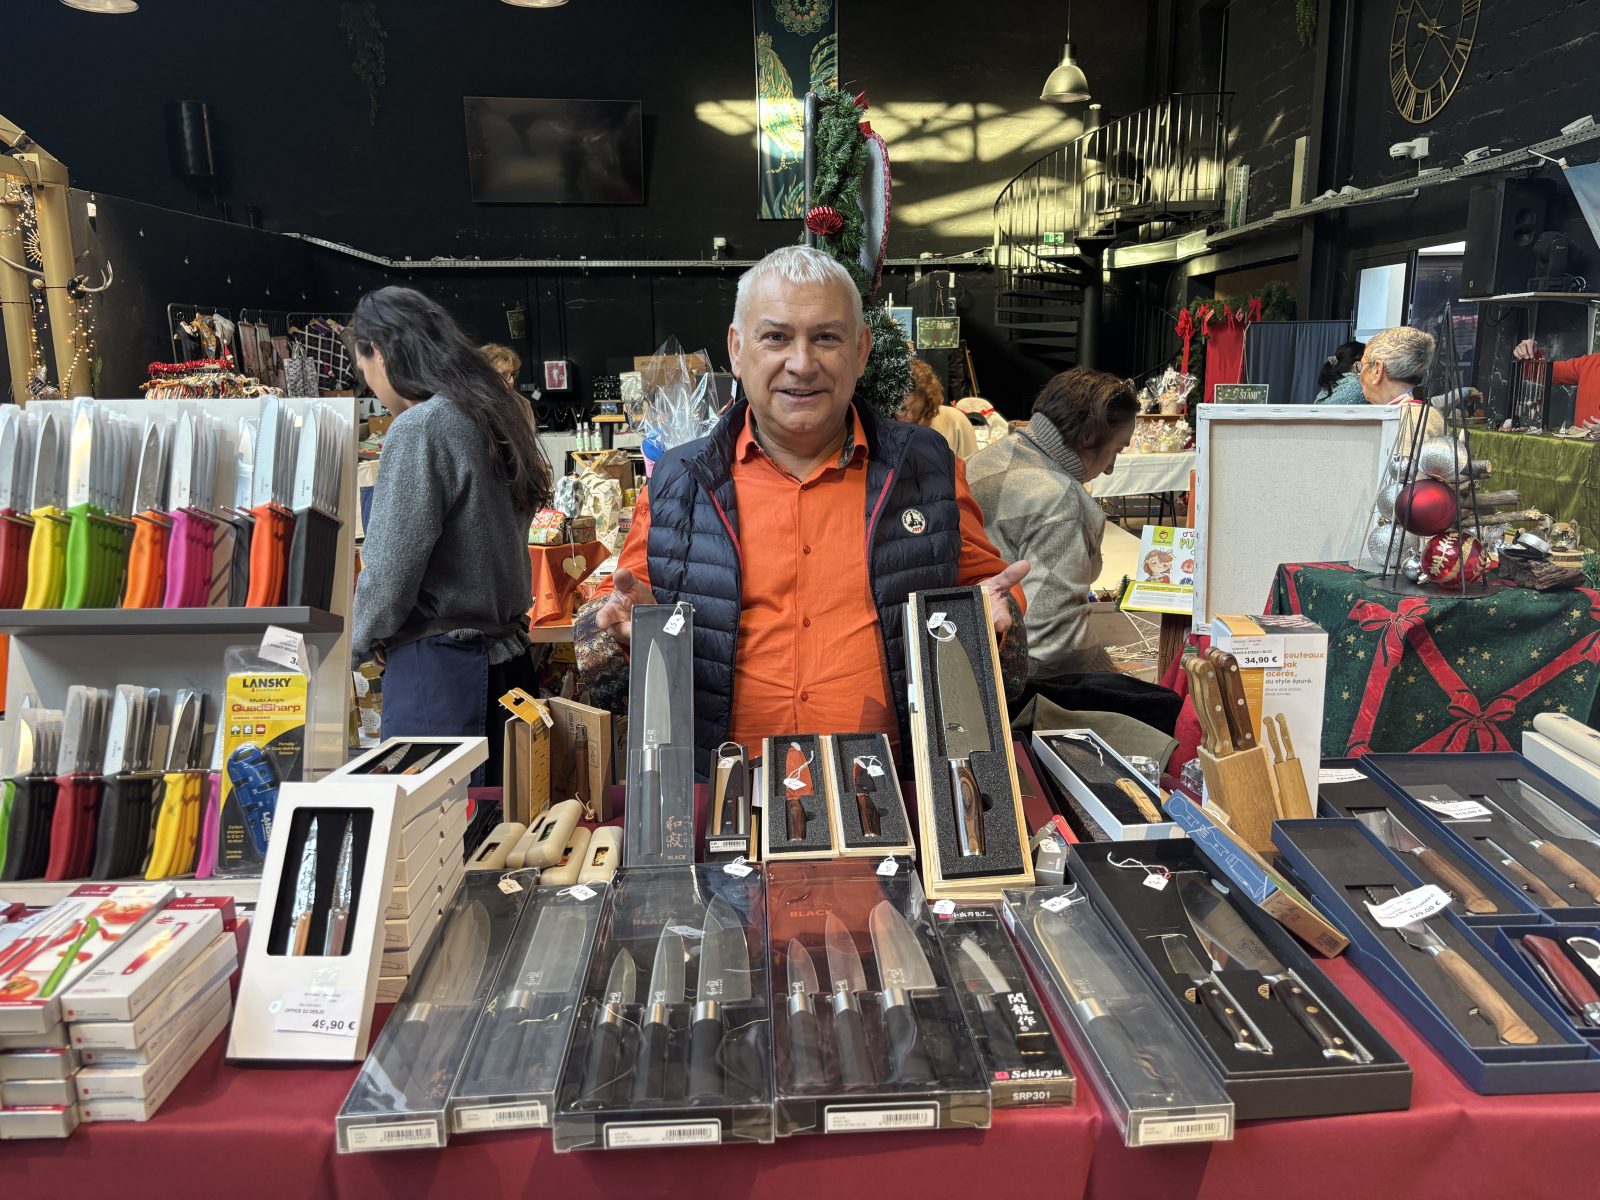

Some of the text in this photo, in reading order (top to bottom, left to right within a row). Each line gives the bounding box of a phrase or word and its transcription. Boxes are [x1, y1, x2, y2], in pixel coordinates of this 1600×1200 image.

[1179, 538, 1195, 550] PU
[1244, 656, 1278, 665] 34,90 €
[1265, 670, 1298, 678] acérés,
[242, 677, 292, 689] LANSKY
[1275, 678, 1291, 686] style
[231, 703, 301, 713] QuadSharp
[789, 908, 832, 918] BLACK
[311, 1018, 356, 1031] 49,90 €
[1010, 1069, 1063, 1080] Sekiryu
[1012, 1090, 1051, 1101] SRP301
